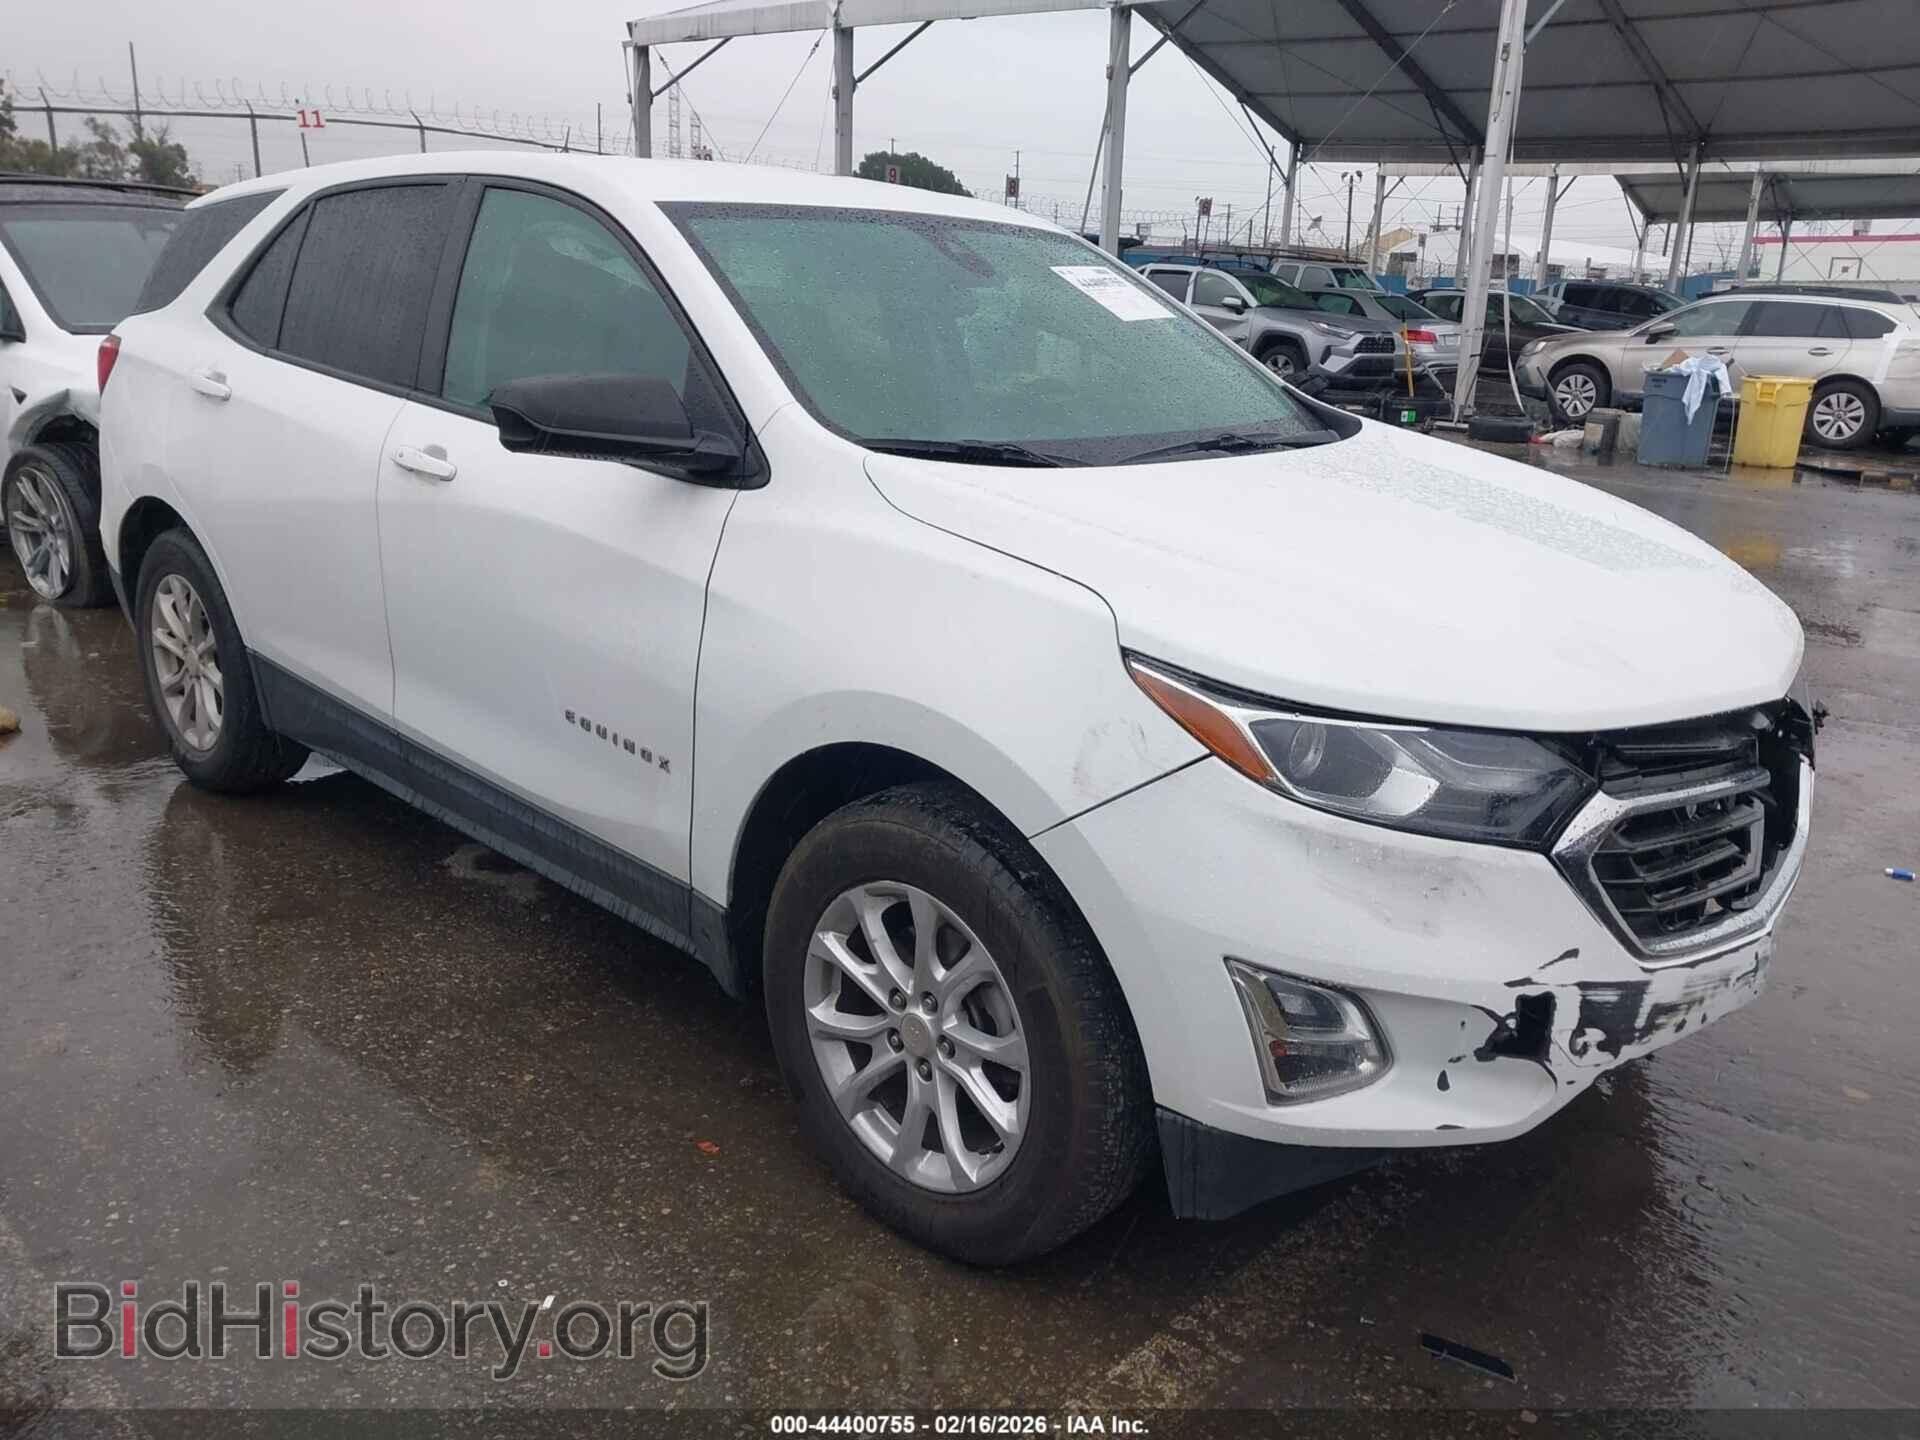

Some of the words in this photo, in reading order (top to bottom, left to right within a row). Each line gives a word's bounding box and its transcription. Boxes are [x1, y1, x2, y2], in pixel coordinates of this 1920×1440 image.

[297, 109, 325, 128] 11
[888, 167, 897, 183] 9
[564, 709, 671, 774] EQUINOX
